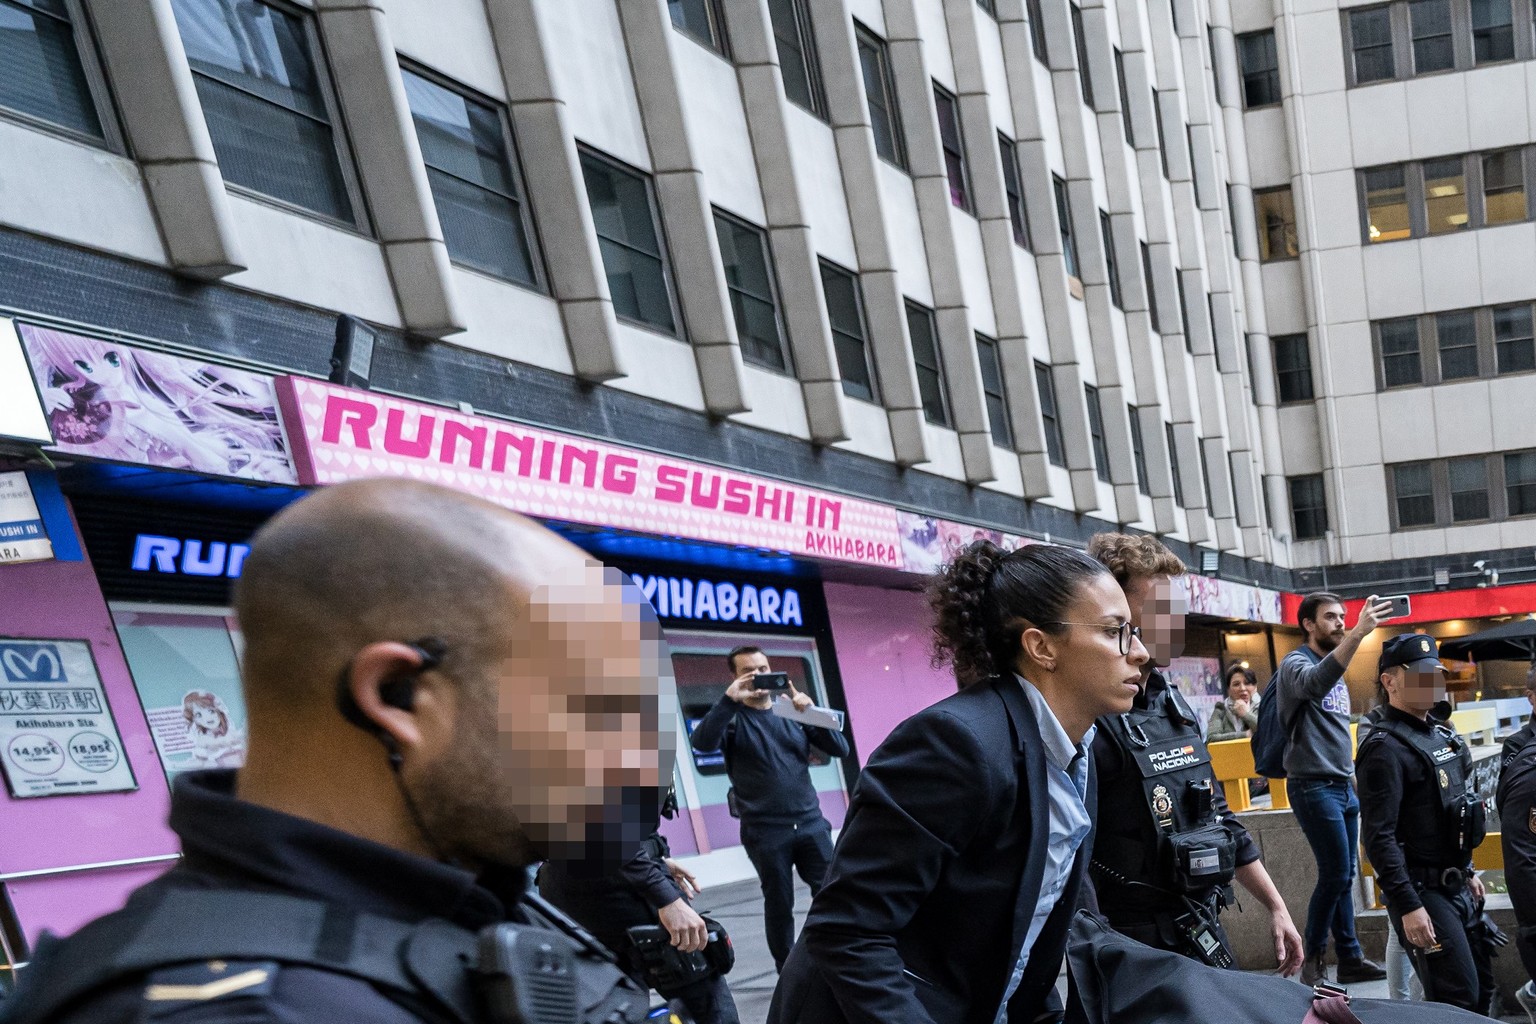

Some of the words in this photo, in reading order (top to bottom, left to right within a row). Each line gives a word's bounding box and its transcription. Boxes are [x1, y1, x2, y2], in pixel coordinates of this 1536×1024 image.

[322, 395, 641, 496] RUNNING
[654, 463, 795, 523] SUSHI
[806, 496, 842, 531] IN
[26, 524, 38, 535] IN
[805, 531, 897, 565] AKIHABARA
[16, 718, 75, 729] Akihabara
[1153, 755, 1199, 771] NACIONAL
